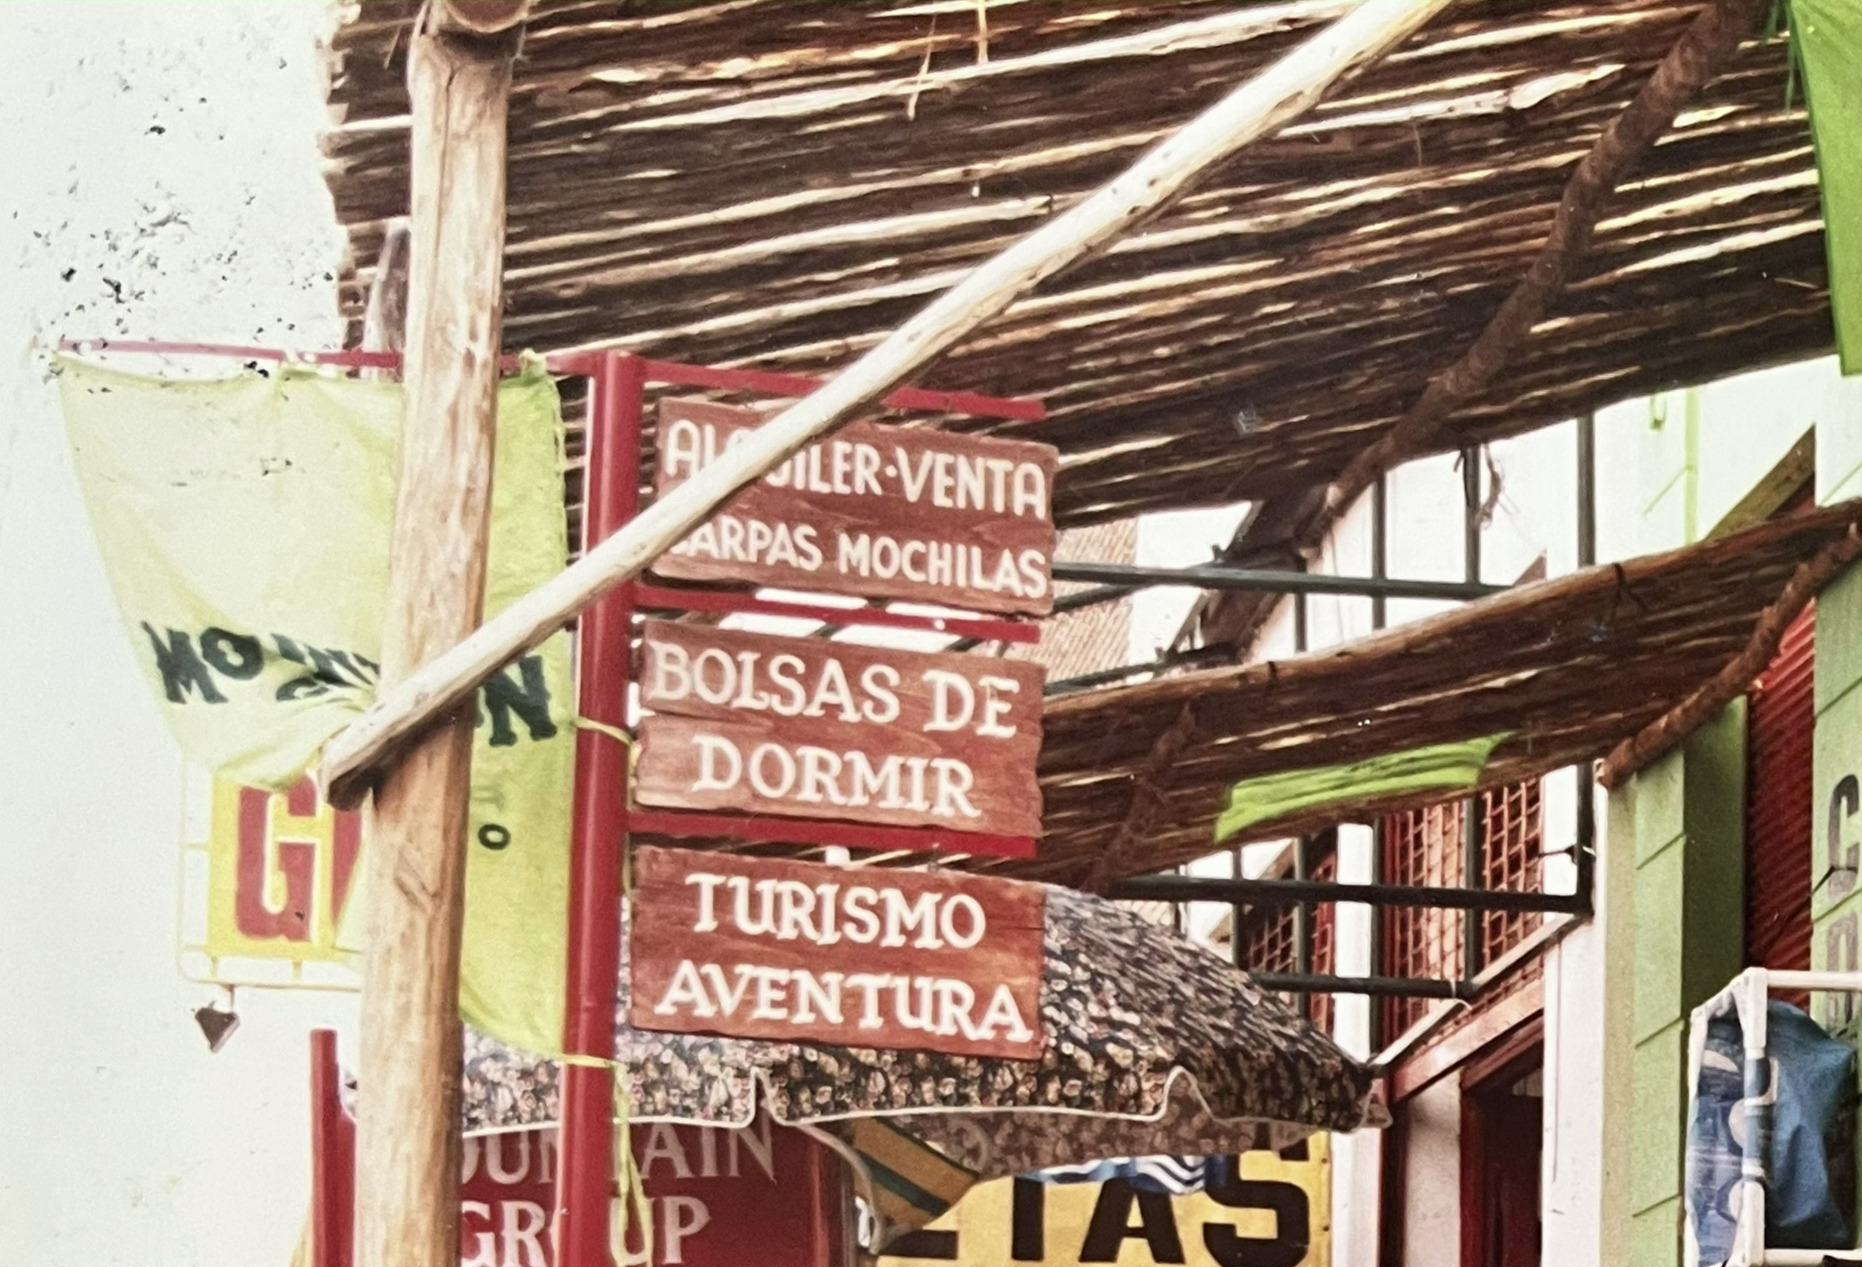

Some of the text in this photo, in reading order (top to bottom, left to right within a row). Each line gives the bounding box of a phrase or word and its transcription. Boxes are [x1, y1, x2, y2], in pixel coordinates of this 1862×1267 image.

[670, 514, 1048, 599] ARPAS MOCHILAS
[648, 640, 901, 725] BOLSAS
[922, 669, 1021, 739] DE
[691, 735, 982, 818] DORMIR
[685, 872, 987, 949] TURISMO
[654, 958, 1034, 1042] AVENTURA
